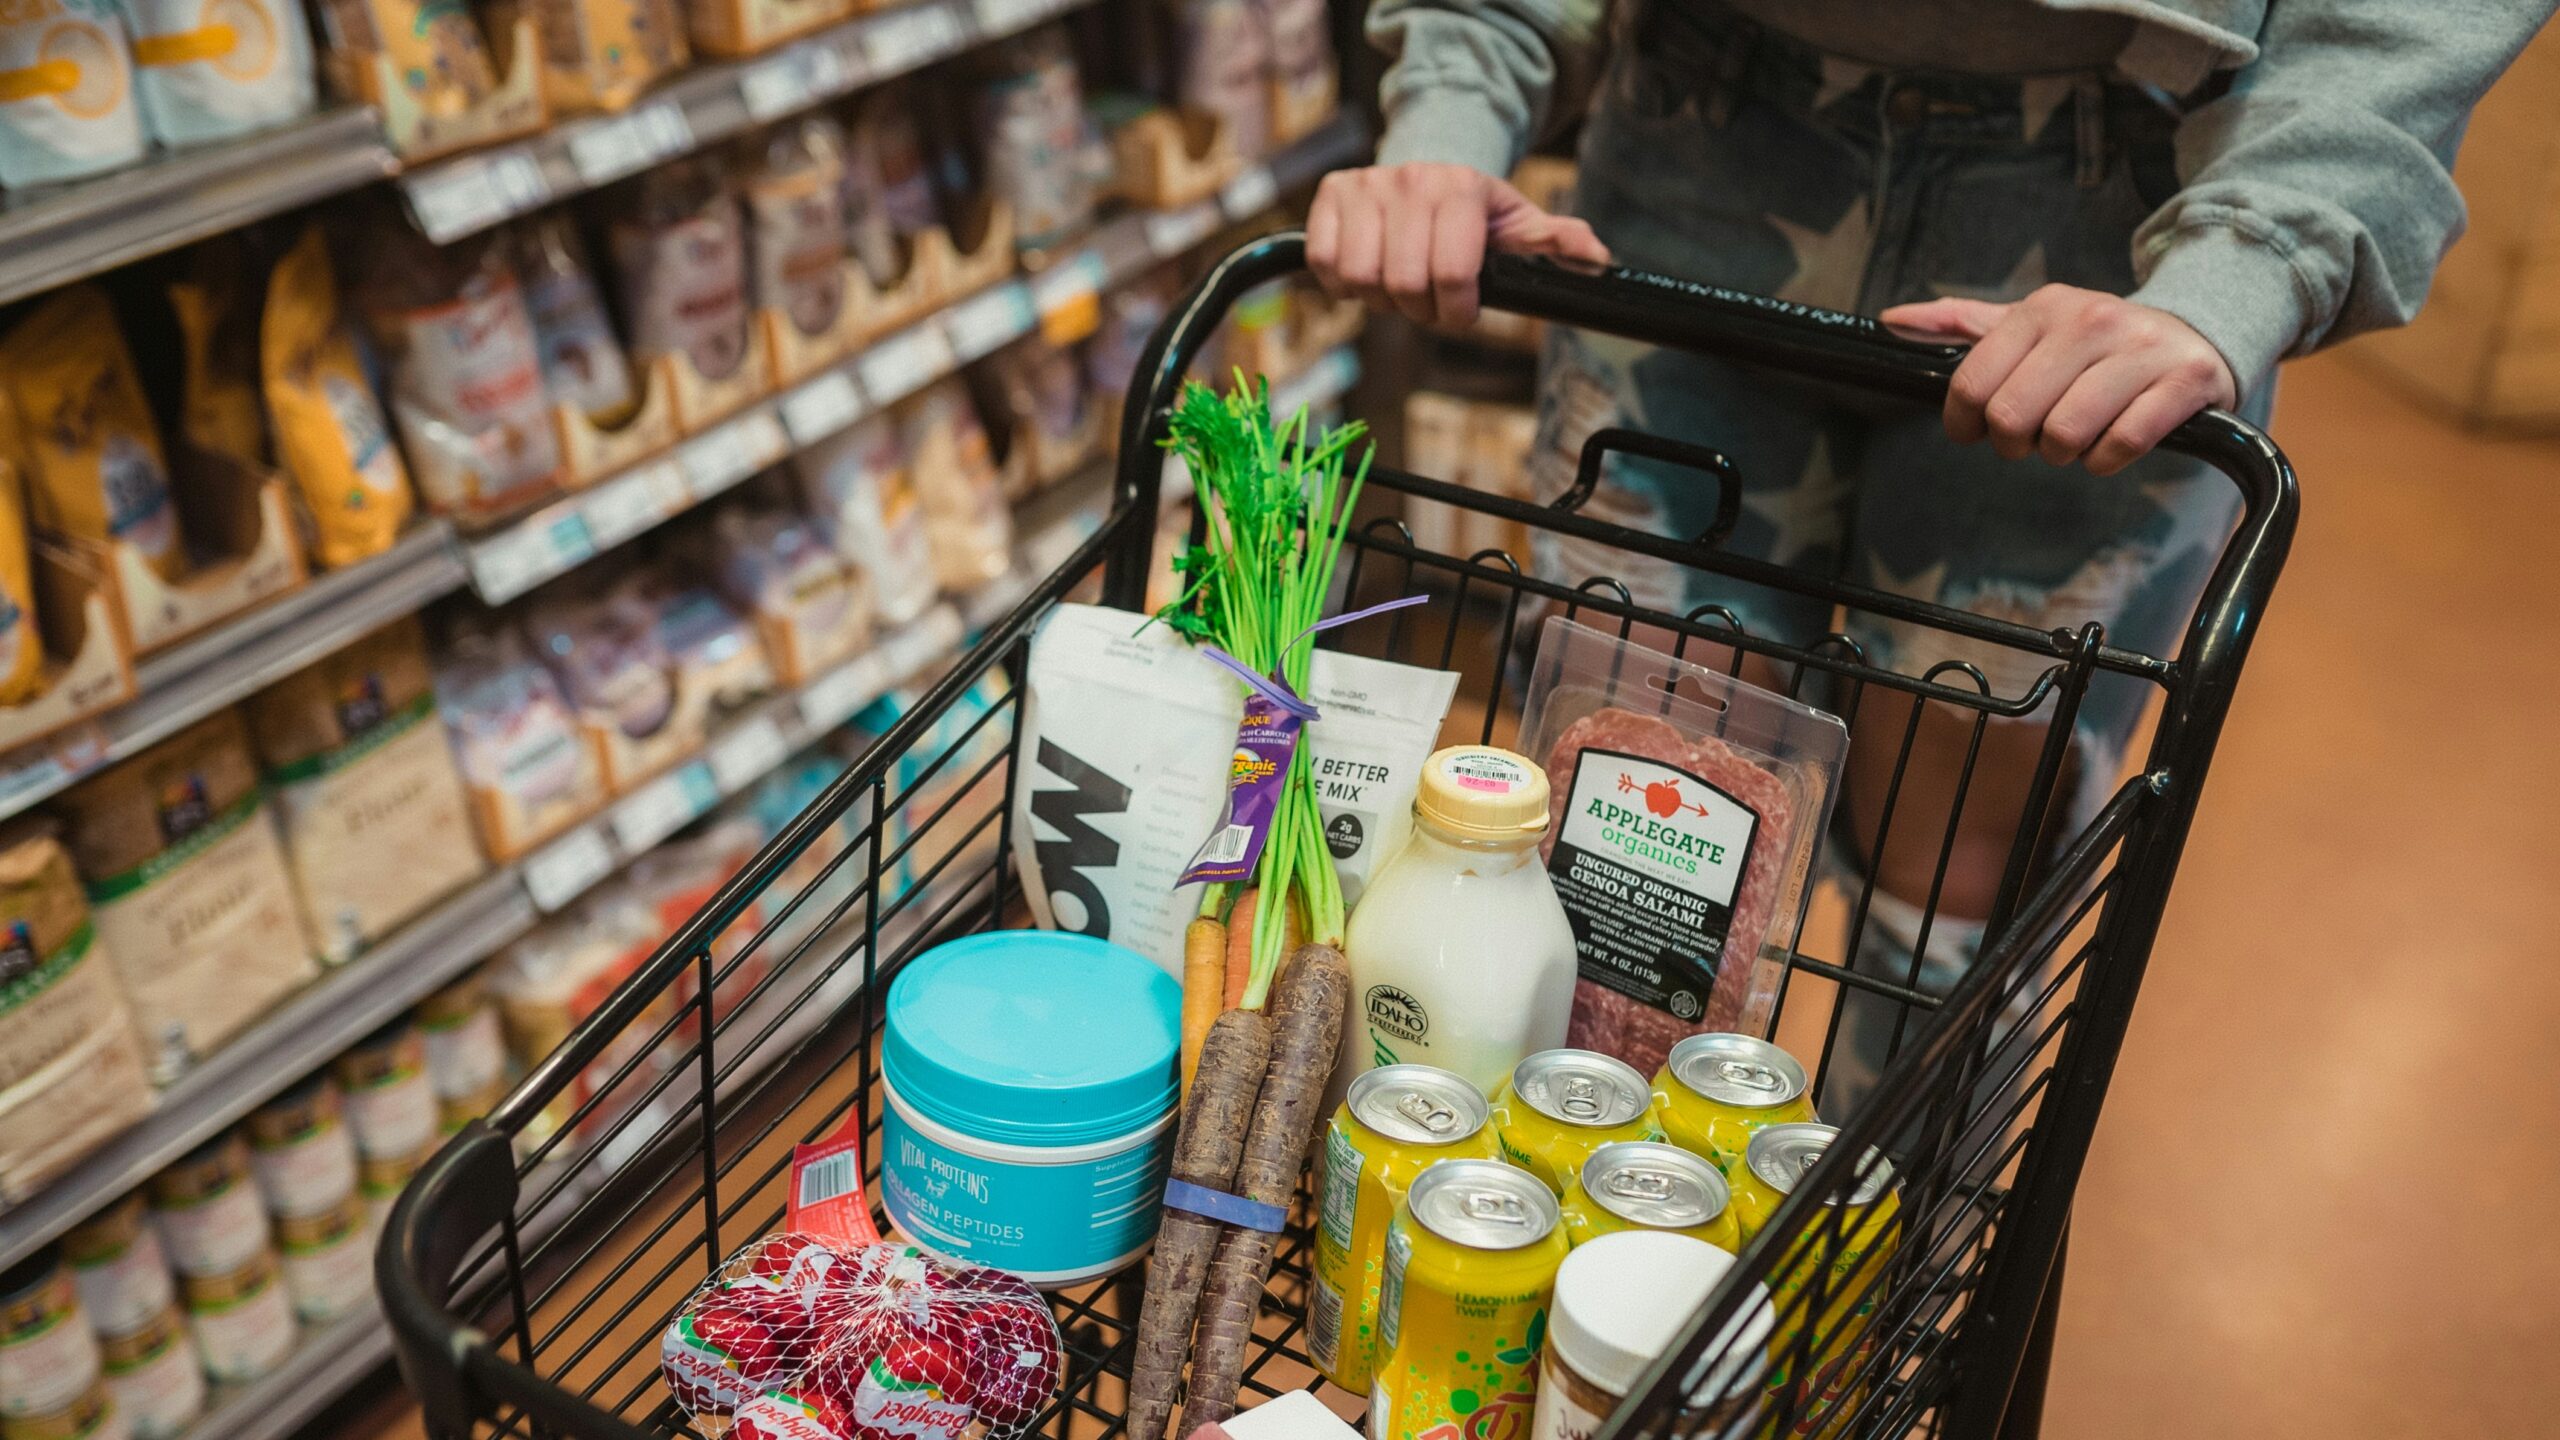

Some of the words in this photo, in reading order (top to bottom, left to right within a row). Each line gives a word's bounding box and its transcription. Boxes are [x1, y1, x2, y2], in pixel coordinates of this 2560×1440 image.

[1232, 758, 1277, 773] rganic
[1321, 758, 1390, 784] BETTER
[1326, 782, 1362, 803] MIX
[1339, 820, 1353, 834] 2g
[1586, 797, 1726, 865] APPLEGATE
[1601, 826, 1698, 875] organics
[1569, 865, 1630, 901] GENOA
[1633, 891, 1706, 930] SALAMI
[1575, 852, 1641, 887] UNCURED
[1642, 879, 1707, 914] ORGANIC
[1567, 901, 1608, 924] ANTIBIOTICS
[1633, 927, 1672, 950] HUMANELY
[1589, 920, 1615, 937] GLUTEN
[1620, 931, 1645, 949] CASEIN
[1644, 940, 1662, 955] FREE
[1611, 904, 1624, 918] and
[1624, 910, 1652, 930] cultured
[1651, 921, 1673, 939] celery
[1671, 930, 1689, 945] juice
[1615, 898, 1637, 914] added
[1636, 907, 1659, 924] except
[1659, 916, 1671, 928] for
[1670, 921, 1690, 936] those
[1689, 929, 1722, 948] naturally
[1577, 940, 1594, 955] NET
[1593, 947, 1609, 963] WT.
[1610, 955, 1618, 967] 4
[1618, 958, 1632, 973] OZ.
[1633, 963, 1663, 985] (113g)
[1590, 932, 1606, 945] KEEP
[1606, 938, 1656, 965] REFRIGERATED
[1371, 998, 1424, 1032] IDAHO
[1373, 1016, 1416, 1041] PREFERRED
[900, 1134, 928, 1170] VITAL
[931, 1156, 989, 1205] PROTEINS
[1095, 1151, 1144, 1173] Supplement
[1508, 1143, 1533, 1166] LIME
[943, 1209, 1025, 1241] PEPTIDES
[1455, 1291, 1508, 1308] LEMON
[1510, 1291, 1539, 1307] LIME
[1455, 1303, 1498, 1320] TWIST
[744, 1401, 828, 1440] abybel
[872, 1400, 968, 1438] Babybel
